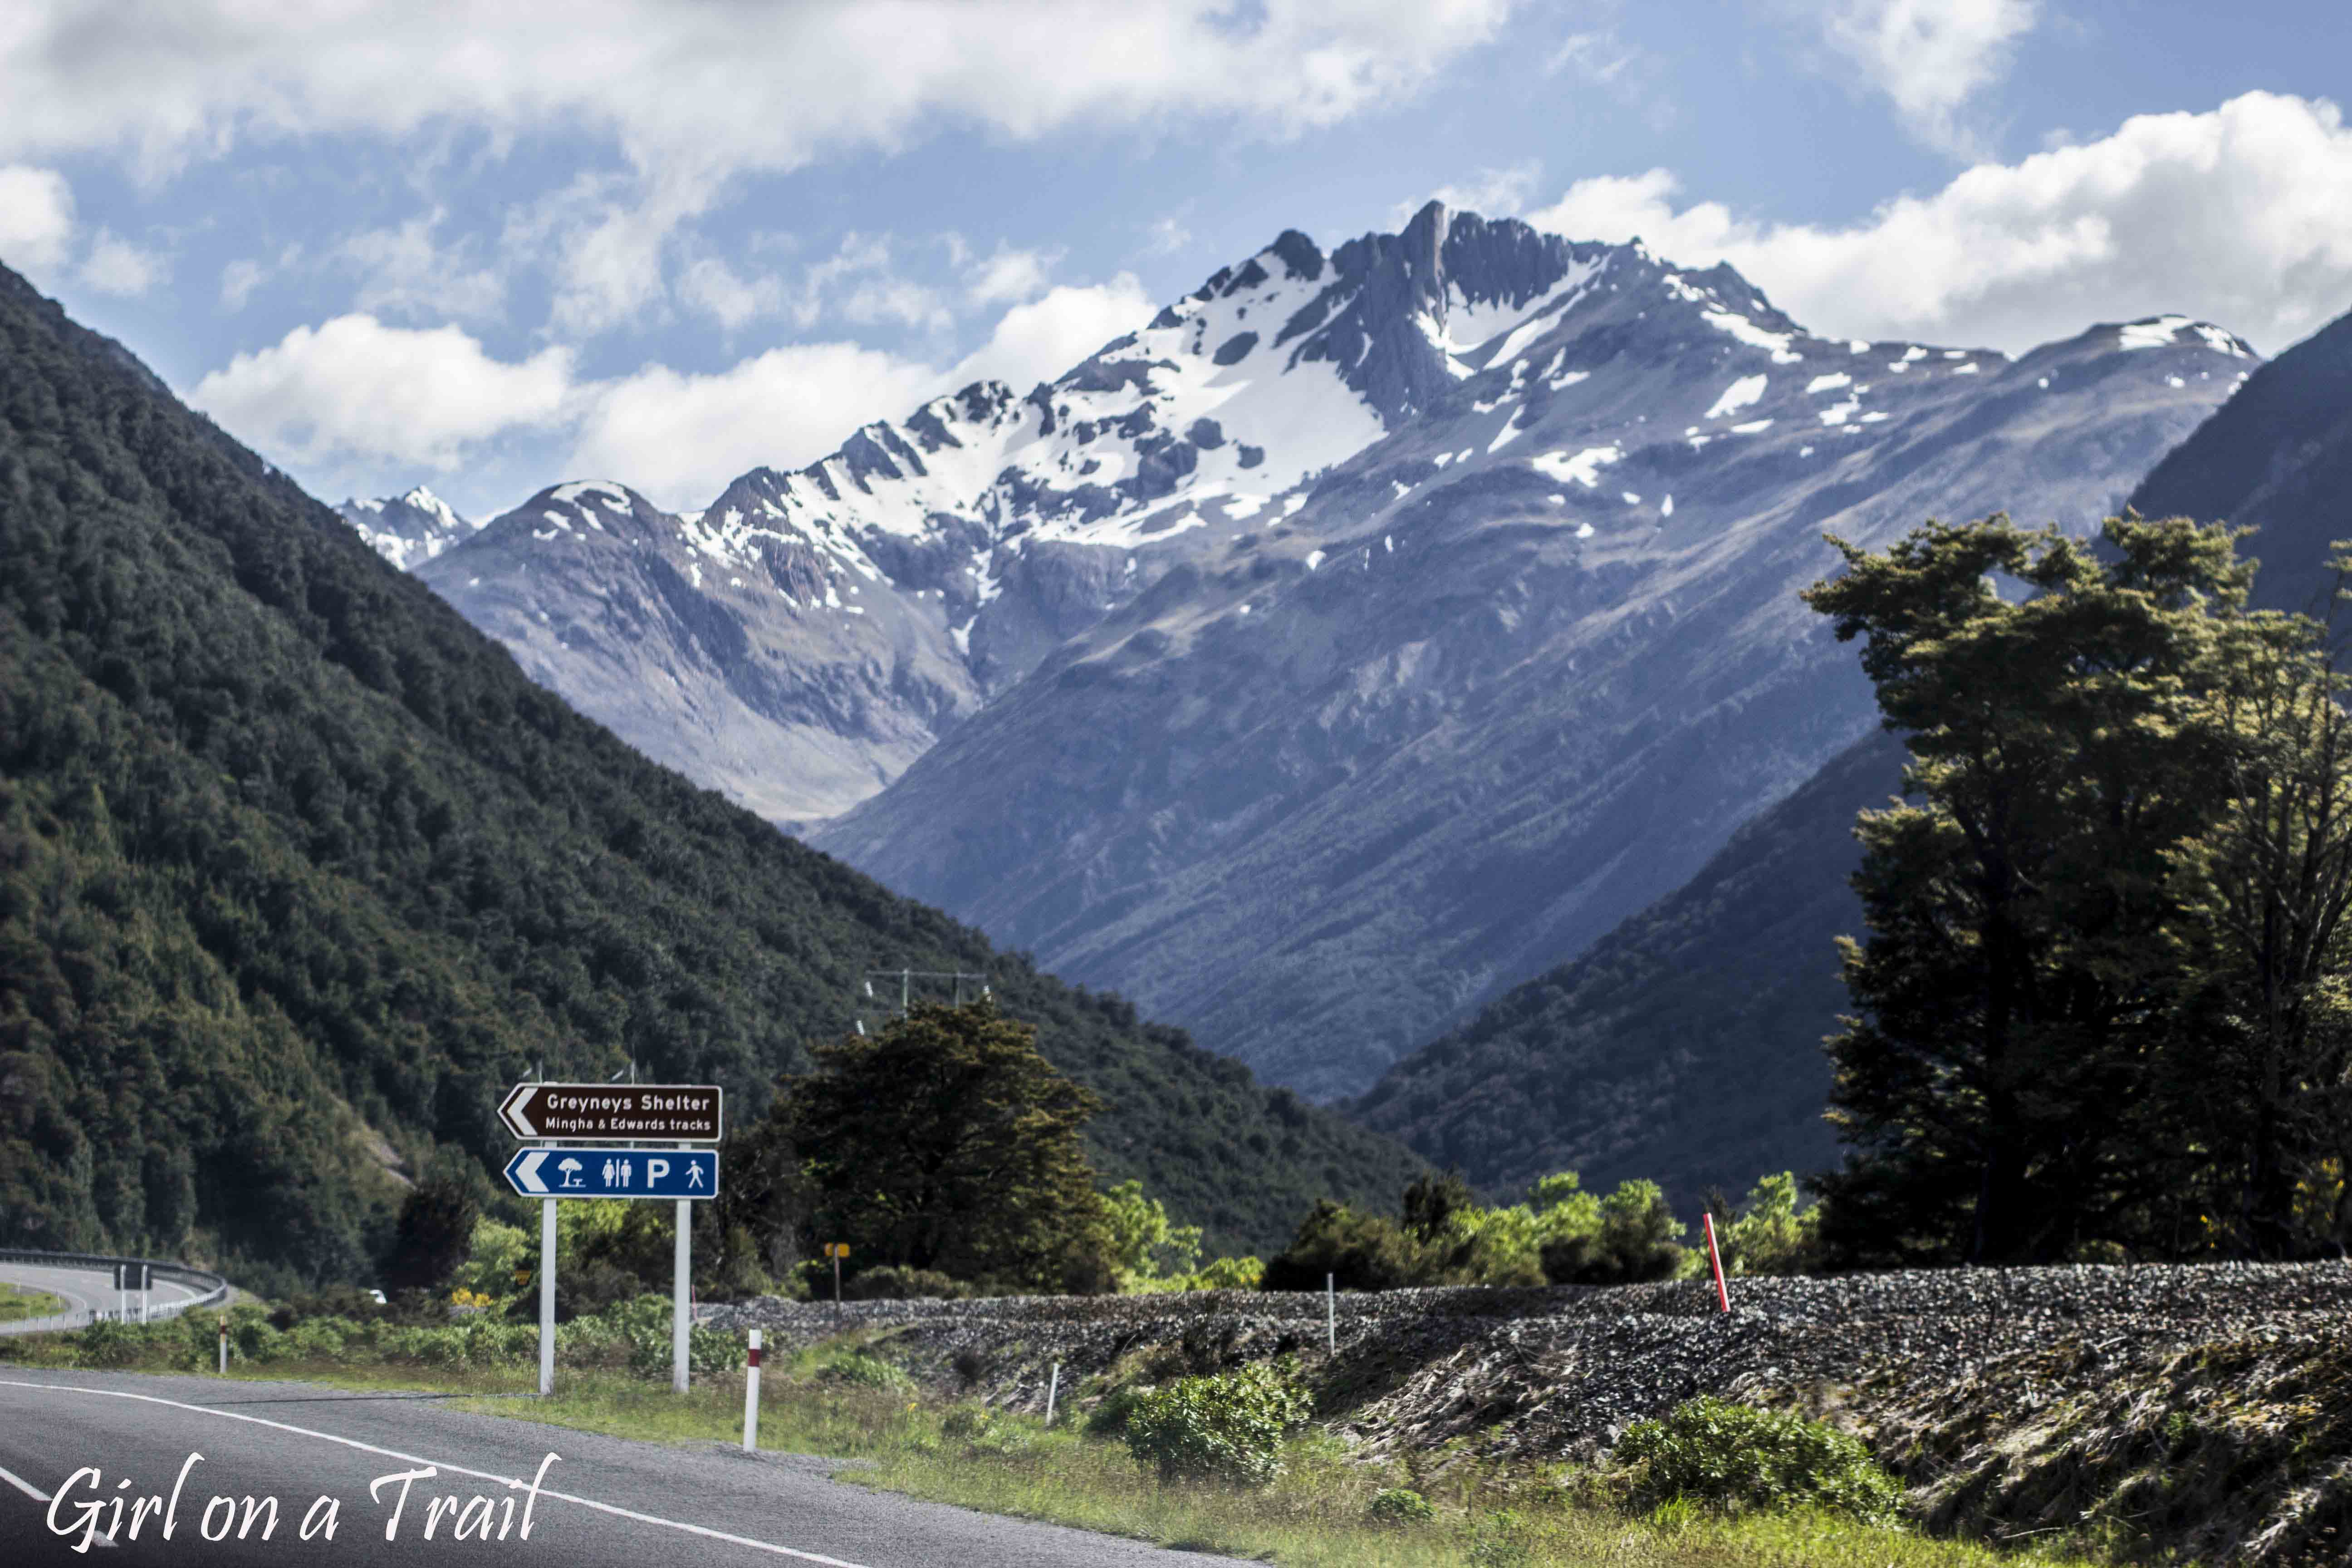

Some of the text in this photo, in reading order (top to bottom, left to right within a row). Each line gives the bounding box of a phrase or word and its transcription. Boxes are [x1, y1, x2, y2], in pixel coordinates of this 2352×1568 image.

[547, 1093, 710, 1113] Greyneys Shelter
[545, 1117, 711, 1132] Mingha & Edwards tracks
[647, 1159, 670, 1189] P
